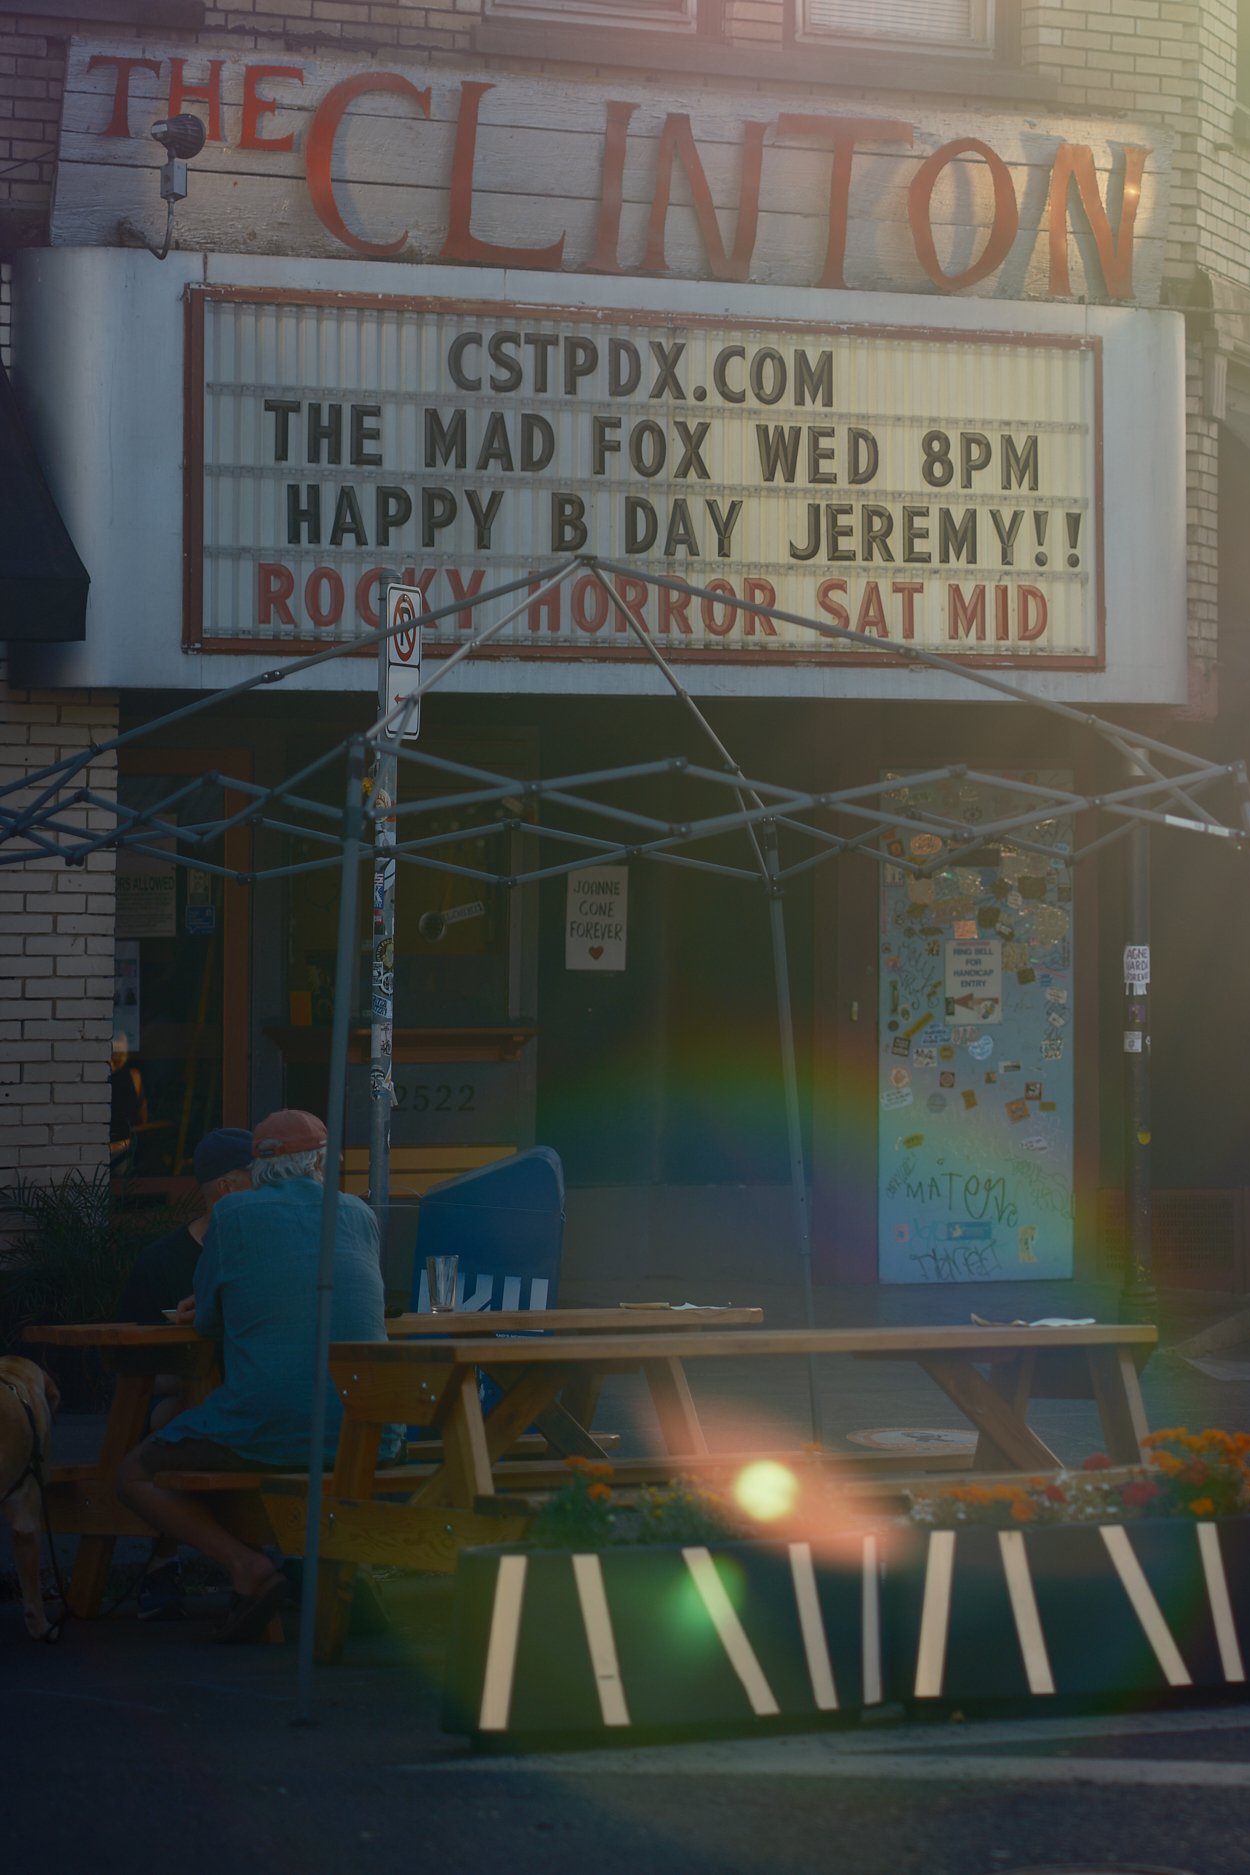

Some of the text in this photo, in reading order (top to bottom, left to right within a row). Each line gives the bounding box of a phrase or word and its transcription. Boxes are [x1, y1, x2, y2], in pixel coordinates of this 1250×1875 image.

[86, 55, 1155, 300] THE CLINTON
[447, 330, 834, 408] CSTPDX.COM
[264, 399, 1039, 491] THE MAD FOX WED 8PM
[286, 483, 1082, 569] HAPPY B DAY JEREMY!!
[527, 565, 778, 637] HORROR
[816, 578, 924, 641] SAT
[948, 583, 1049, 642] MID
[132, 876, 175, 891] ALLOWED
[573, 880, 621, 896] JOANNE
[579, 900, 615, 918] CONE
[570, 920, 623, 942] FOREVER
[966, 958, 982, 966] FOR
[953, 969, 994, 977] HANDICAP
[961, 979, 986, 988] ENTRY
